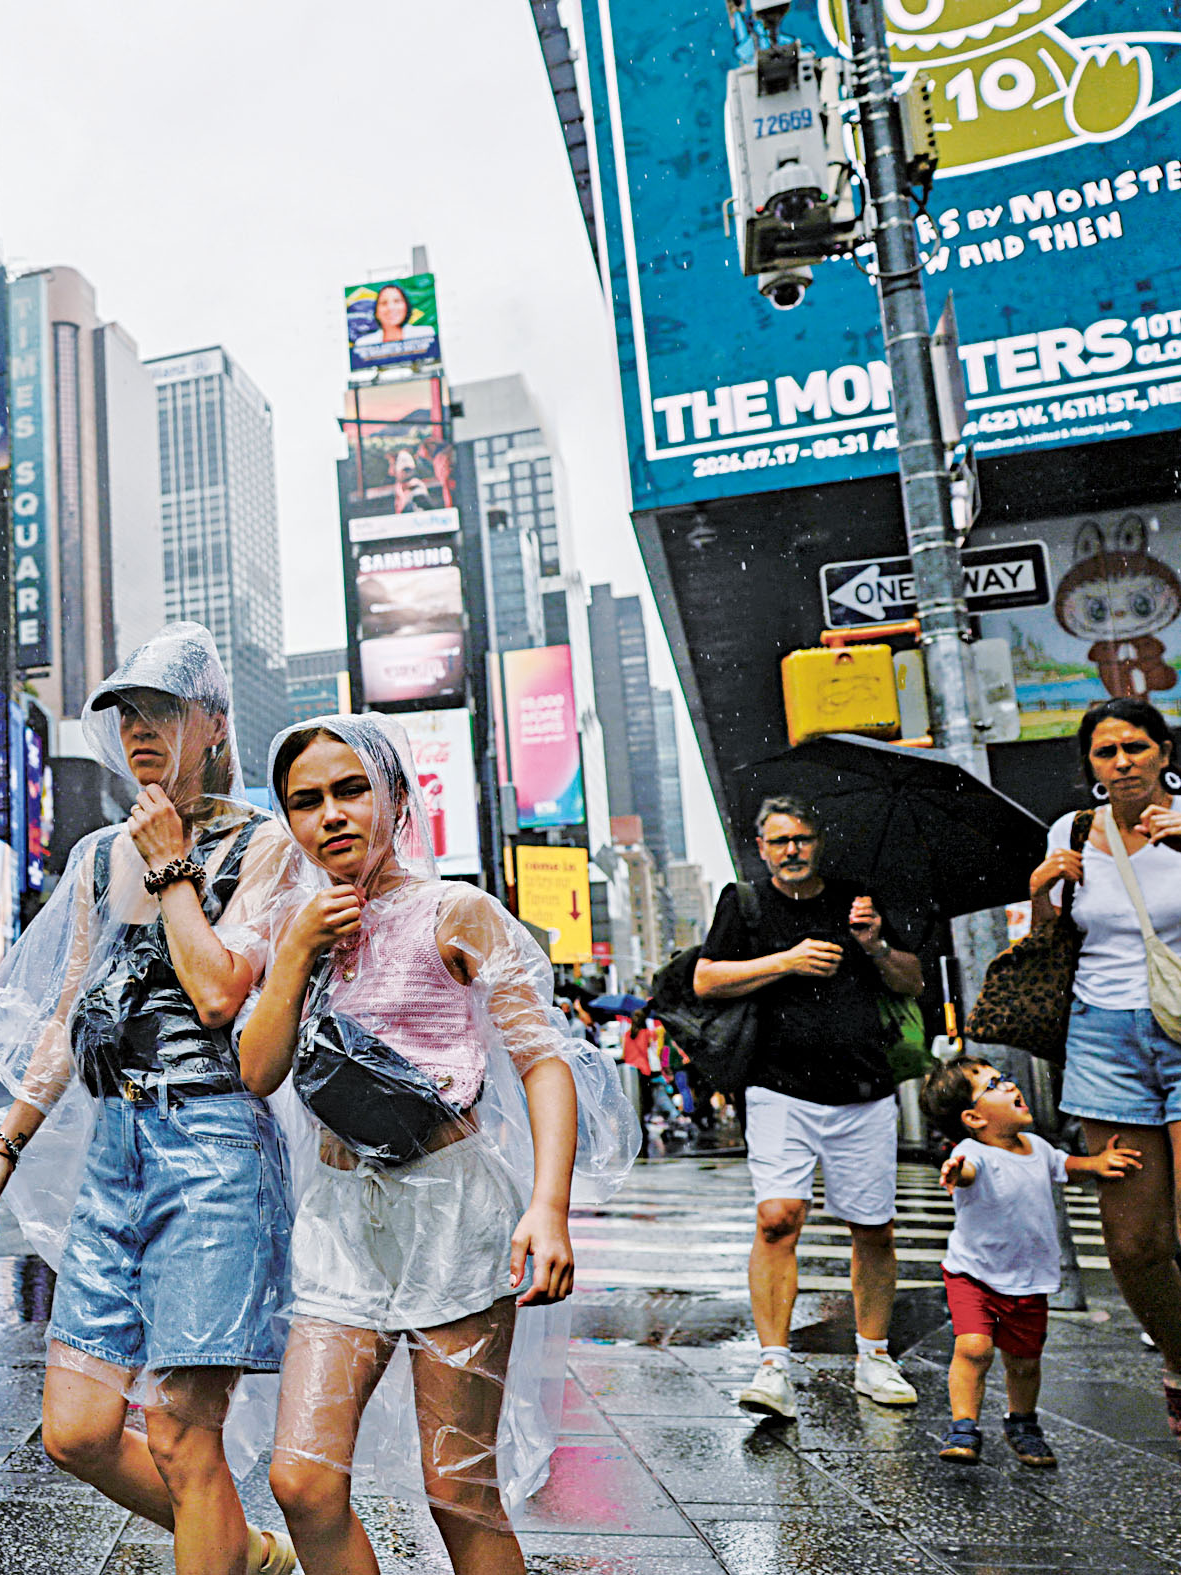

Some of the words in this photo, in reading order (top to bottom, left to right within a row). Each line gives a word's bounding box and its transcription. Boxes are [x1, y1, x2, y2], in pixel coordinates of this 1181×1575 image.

[945, 57, 1036, 121] 10
[753, 108, 813, 139] 72669
[958, 234, 1025, 269] AND
[1028, 210, 1123, 253] THEN
[967, 204, 1004, 231] BY
[11, 296, 37, 440] TIMES
[653, 379, 773, 444] THE
[774, 318, 1133, 426] MONTERS
[978, 409, 1019, 433] 423
[1017, 403, 1049, 428] W.
[14, 460, 41, 646] SQUARE
[359, 546, 453, 573] SAMSUNG
[855, 577, 916, 605] ONE
[963, 564, 1024, 593] WAY
